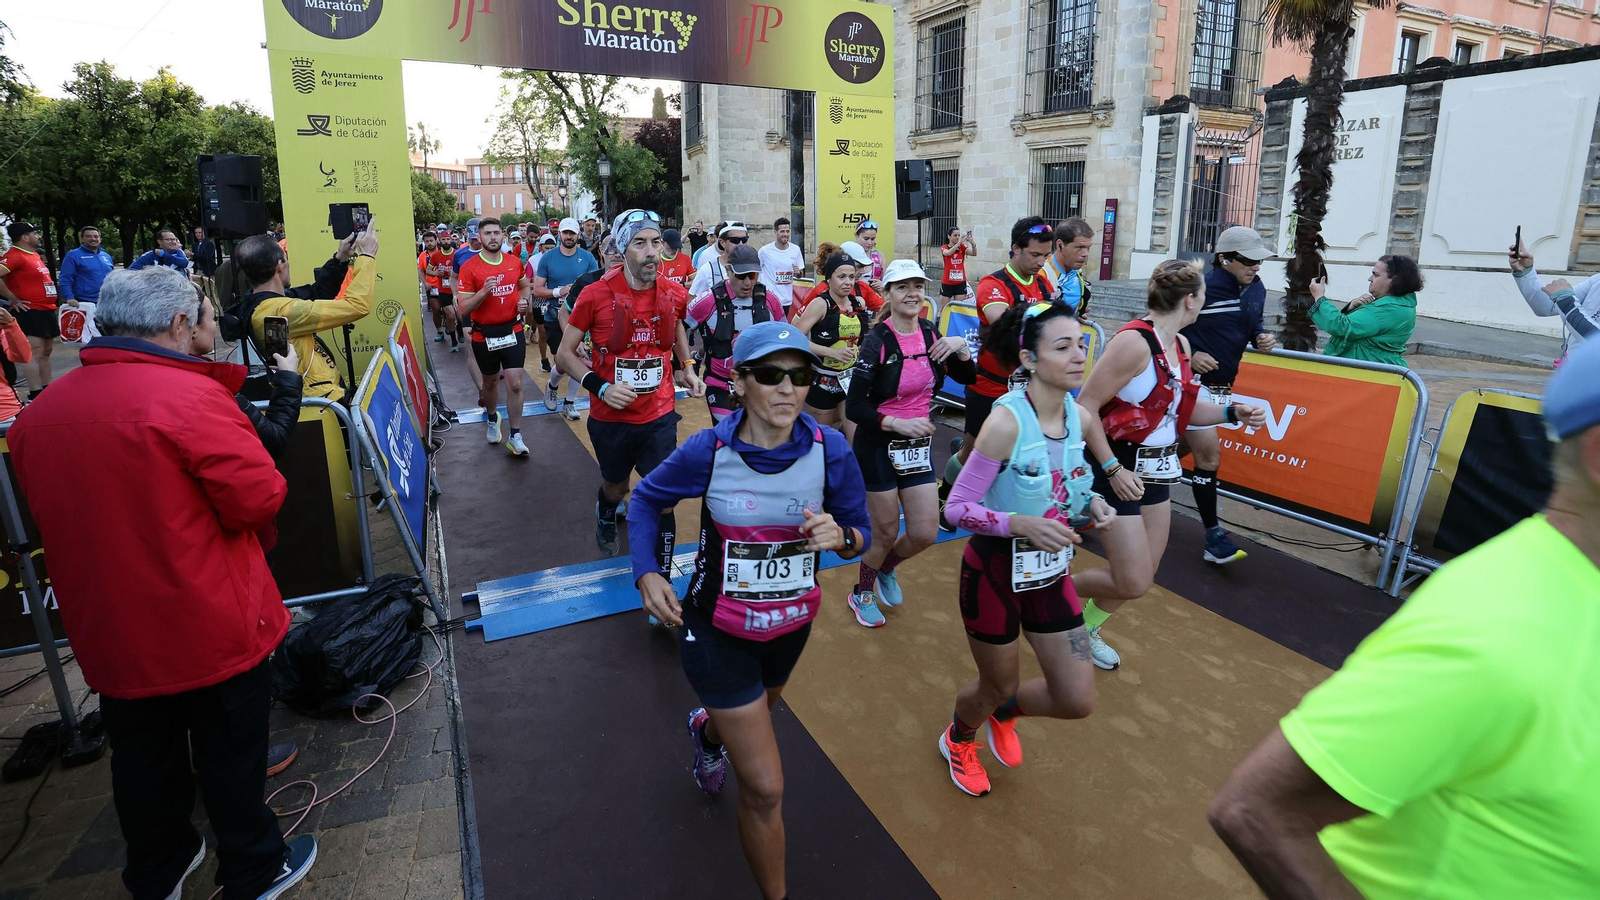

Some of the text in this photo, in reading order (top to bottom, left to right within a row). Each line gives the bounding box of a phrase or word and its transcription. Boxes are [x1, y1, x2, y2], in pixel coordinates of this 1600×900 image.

[558, 0, 698, 51] Sherry
[584, 28, 677, 54] Maratón
[829, 38, 880, 62] Sherry
[838, 53, 873, 64] Maratón
[321, 70, 384, 81] Ayuntamiento
[334, 79, 357, 88] Jerez
[845, 106, 884, 115] Ayuntamiento
[335, 115, 387, 127] Diputación
[1334, 117, 1380, 132] AZAR
[336, 128, 379, 139] de Cádiz
[851, 139, 884, 149] Diputación
[852, 150, 878, 158] de Cádiz
[1334, 147, 1364, 160] REZ
[842, 213, 871, 224] HSN
[491, 284, 515, 293] herry
[632, 332, 650, 342] LAGA
[342, 345, 384, 353] CVIJERE
[633, 370, 648, 381] 36
[901, 449, 920, 462] 105
[1156, 458, 1171, 471] 25
[753, 558, 791, 580] 103
